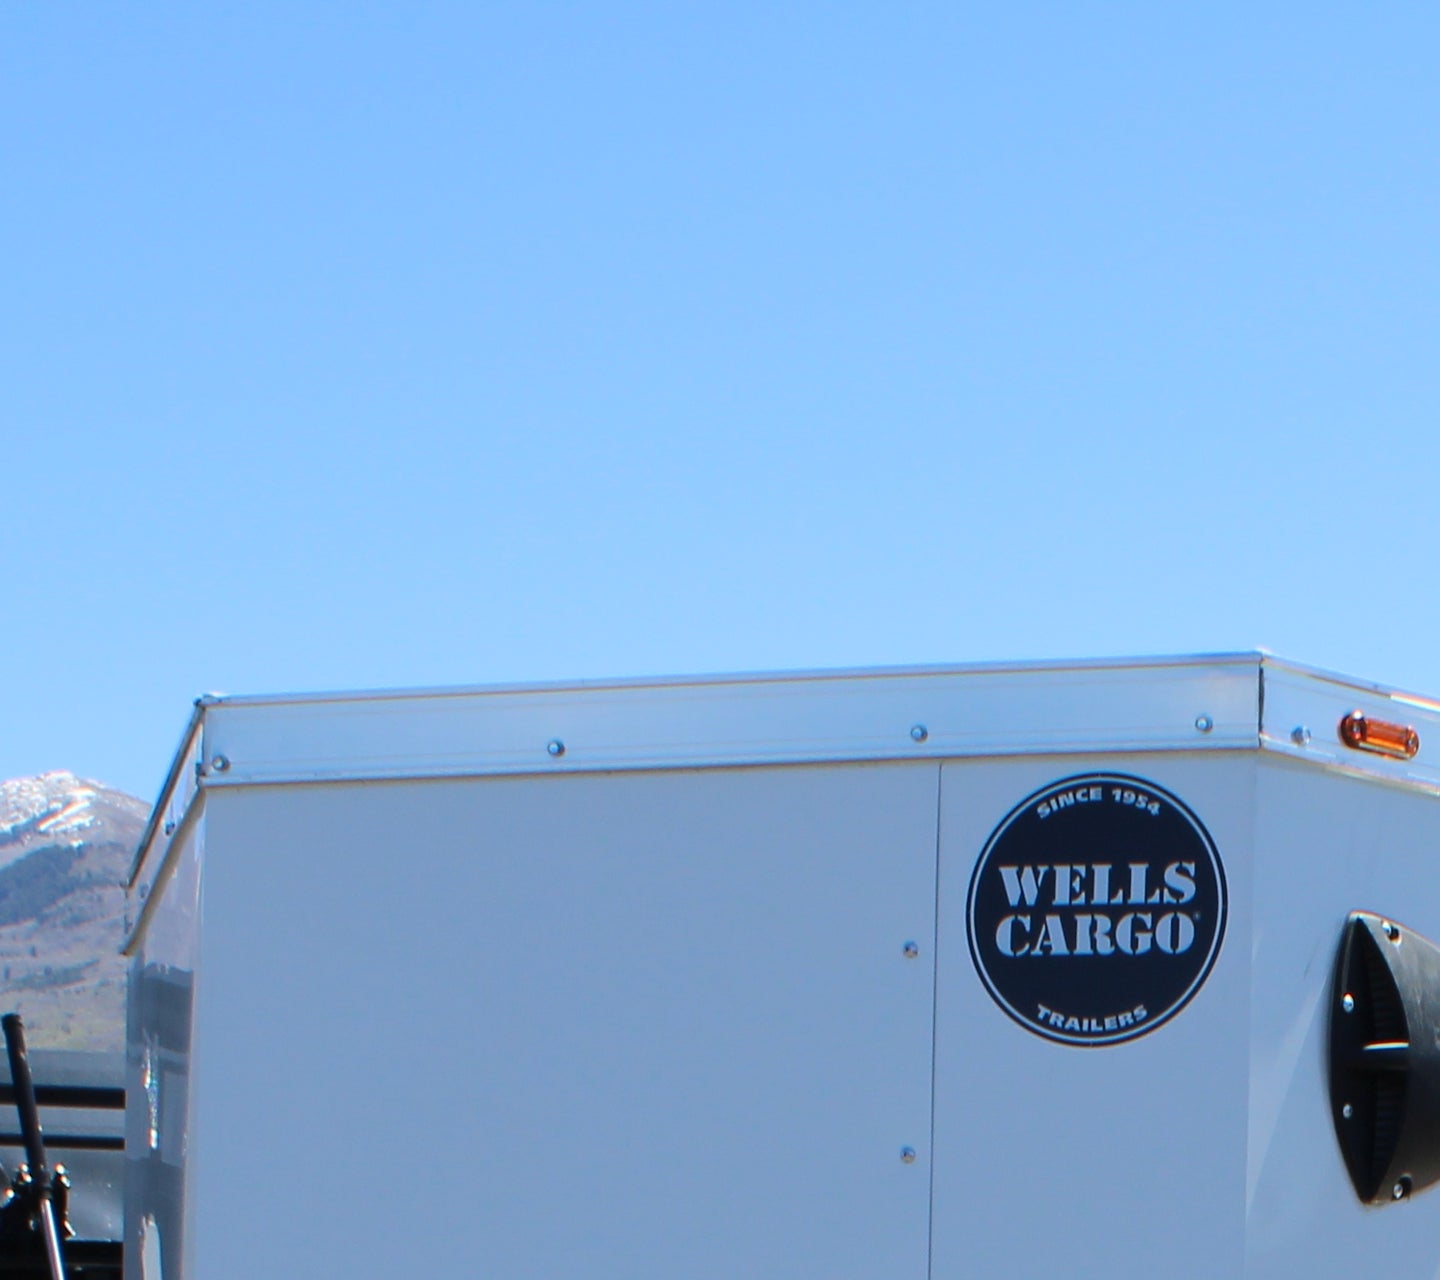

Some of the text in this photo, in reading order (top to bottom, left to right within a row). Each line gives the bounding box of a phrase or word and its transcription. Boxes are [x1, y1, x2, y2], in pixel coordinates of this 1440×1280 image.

[1036, 786, 1161, 820] SINCE 1954
[998, 861, 1198, 907] WELLS
[995, 911, 1197, 958] CARGO
[1037, 1003, 1149, 1033] TRAILERS
